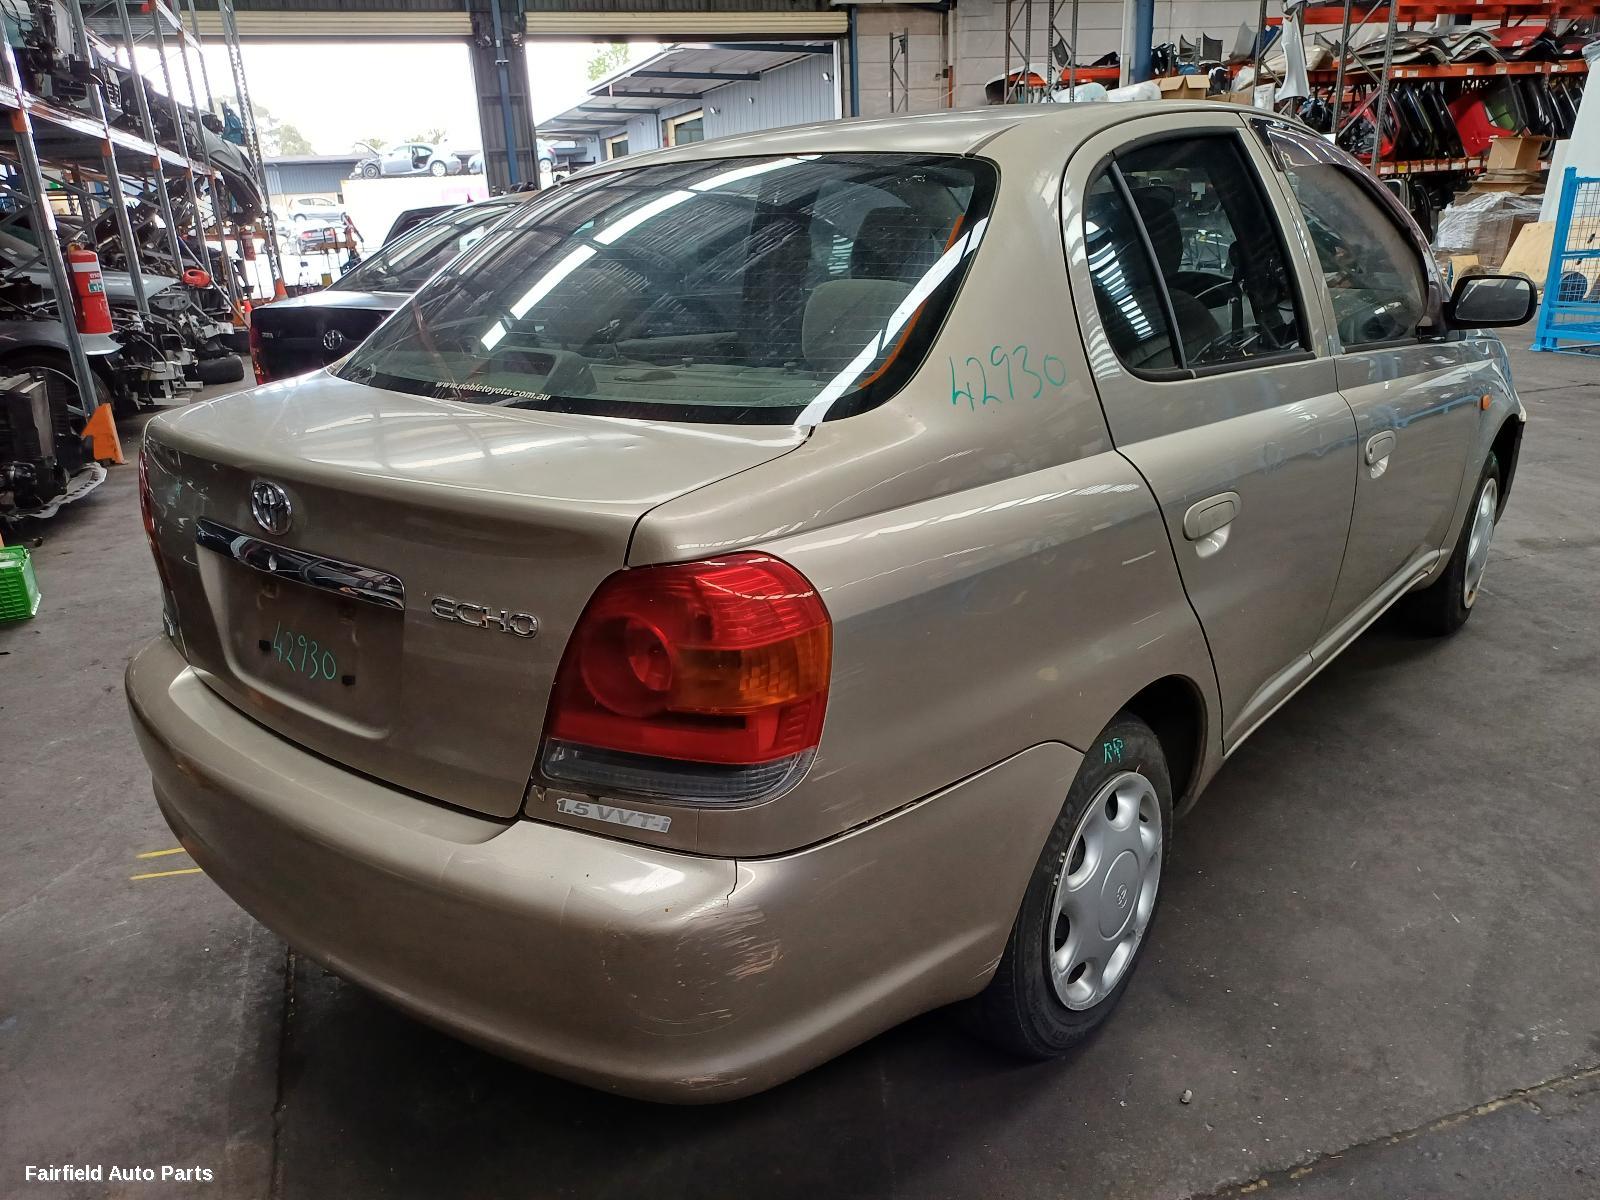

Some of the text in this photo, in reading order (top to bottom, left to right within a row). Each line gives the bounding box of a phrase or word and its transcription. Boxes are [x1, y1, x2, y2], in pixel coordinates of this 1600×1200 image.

[434, 380, 552, 401] www.nobletoyota.com.au
[949, 344, 1067, 412] 42930
[430, 594, 541, 639] ECHO
[272, 620, 337, 681] 42930
